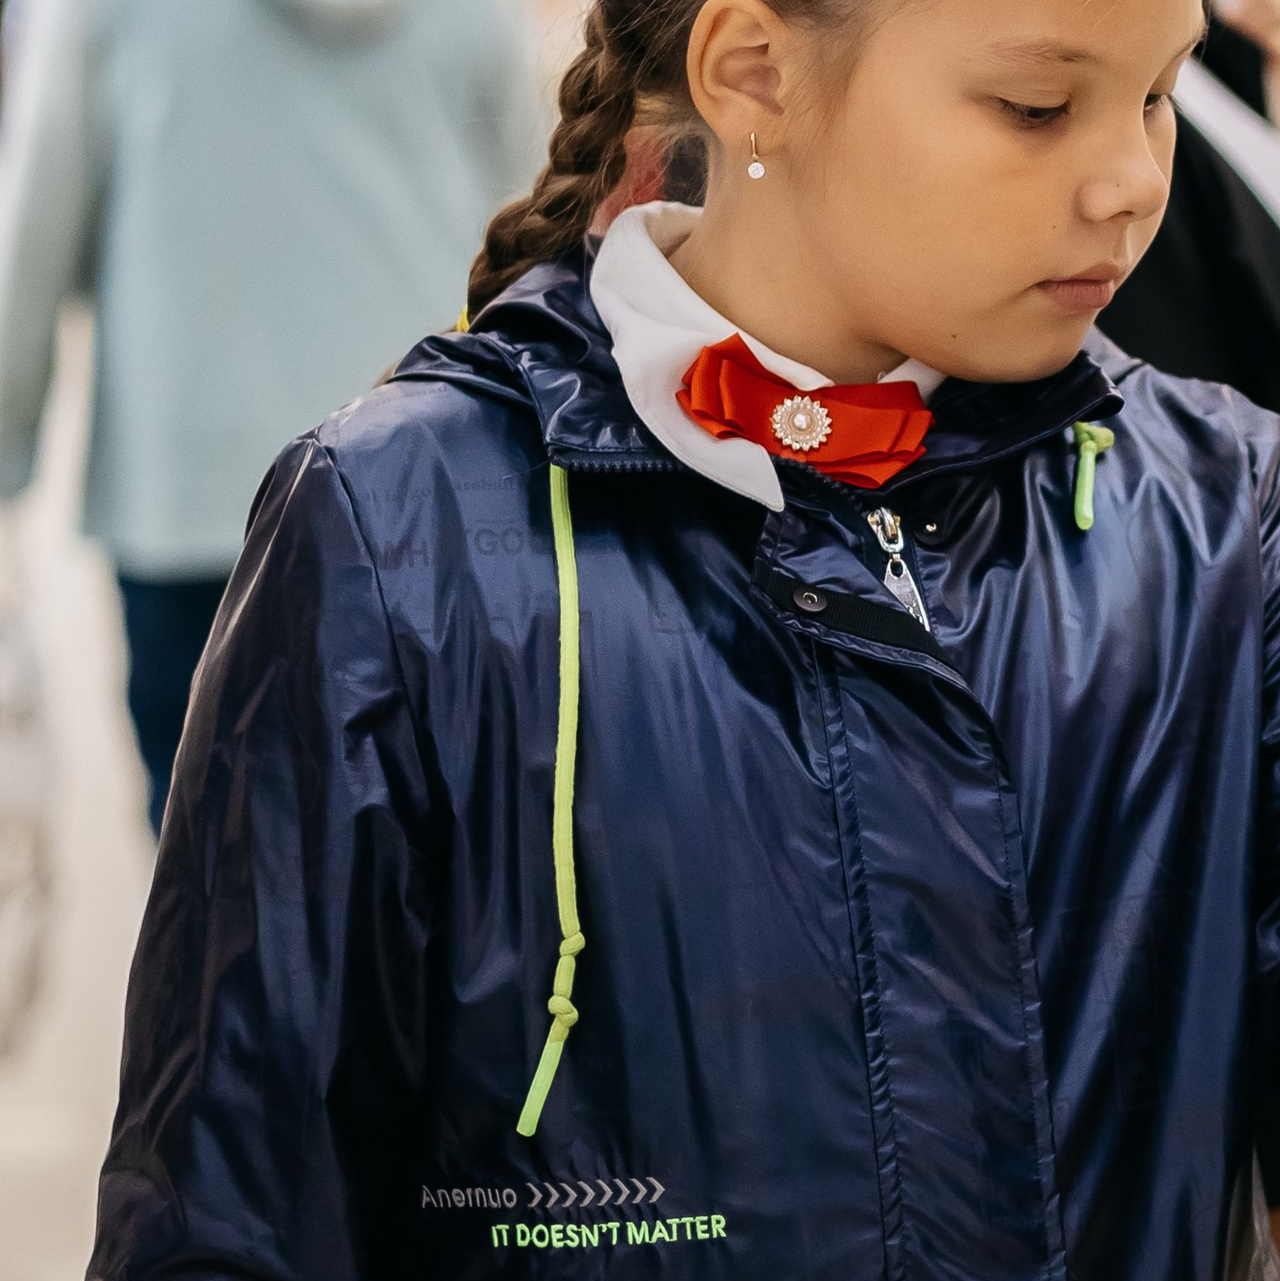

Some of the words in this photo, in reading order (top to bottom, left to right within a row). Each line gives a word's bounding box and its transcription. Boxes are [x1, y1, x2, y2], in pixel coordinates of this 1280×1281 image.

[491, 1224, 510, 1248] IT
[515, 1222, 621, 1249] DOESN'T
[625, 1214, 727, 1246] MATTER
